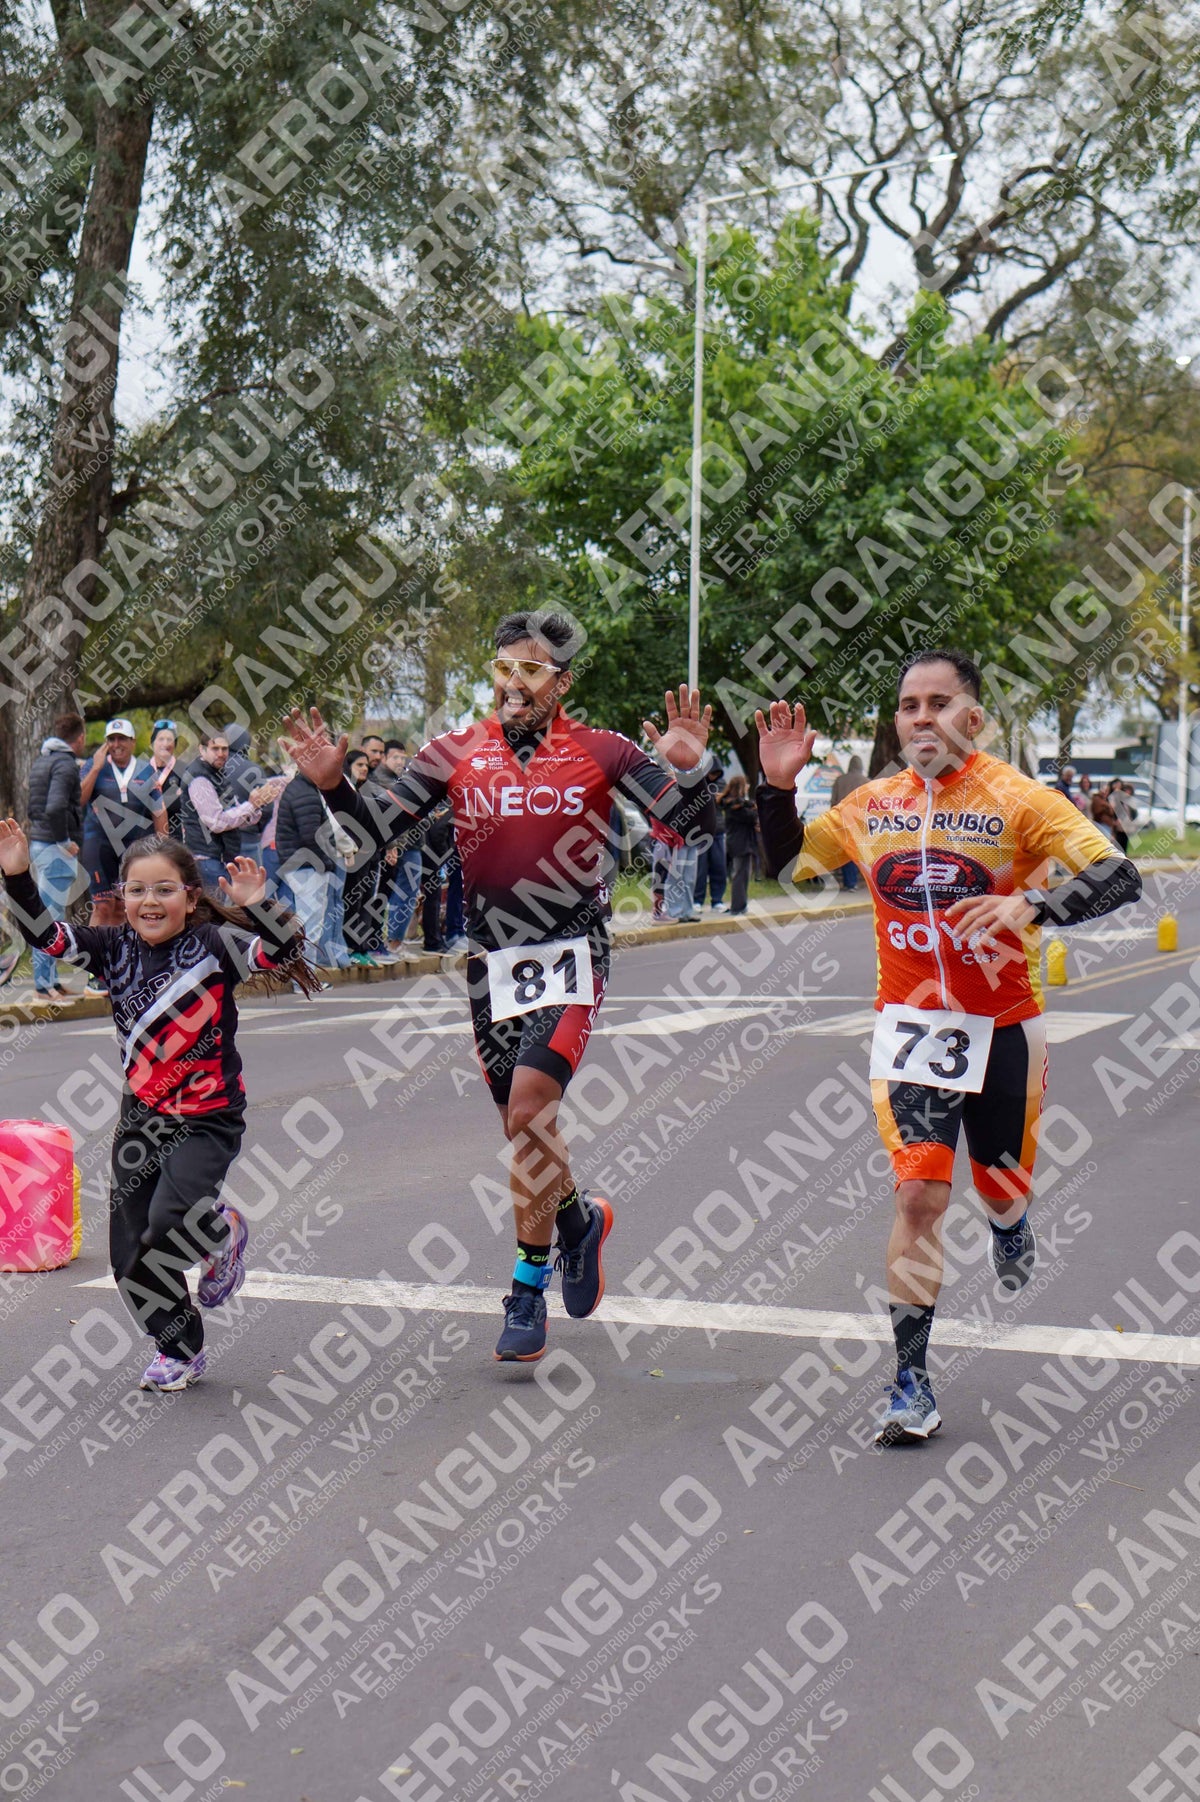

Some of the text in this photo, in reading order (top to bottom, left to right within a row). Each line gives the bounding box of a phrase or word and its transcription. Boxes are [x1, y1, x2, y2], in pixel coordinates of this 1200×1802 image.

[463, 785, 587, 817] INEOS
[867, 812, 1004, 836] PASO RUBIO
[511, 948, 579, 1005] 81
[892, 1021, 971, 1080] 73
